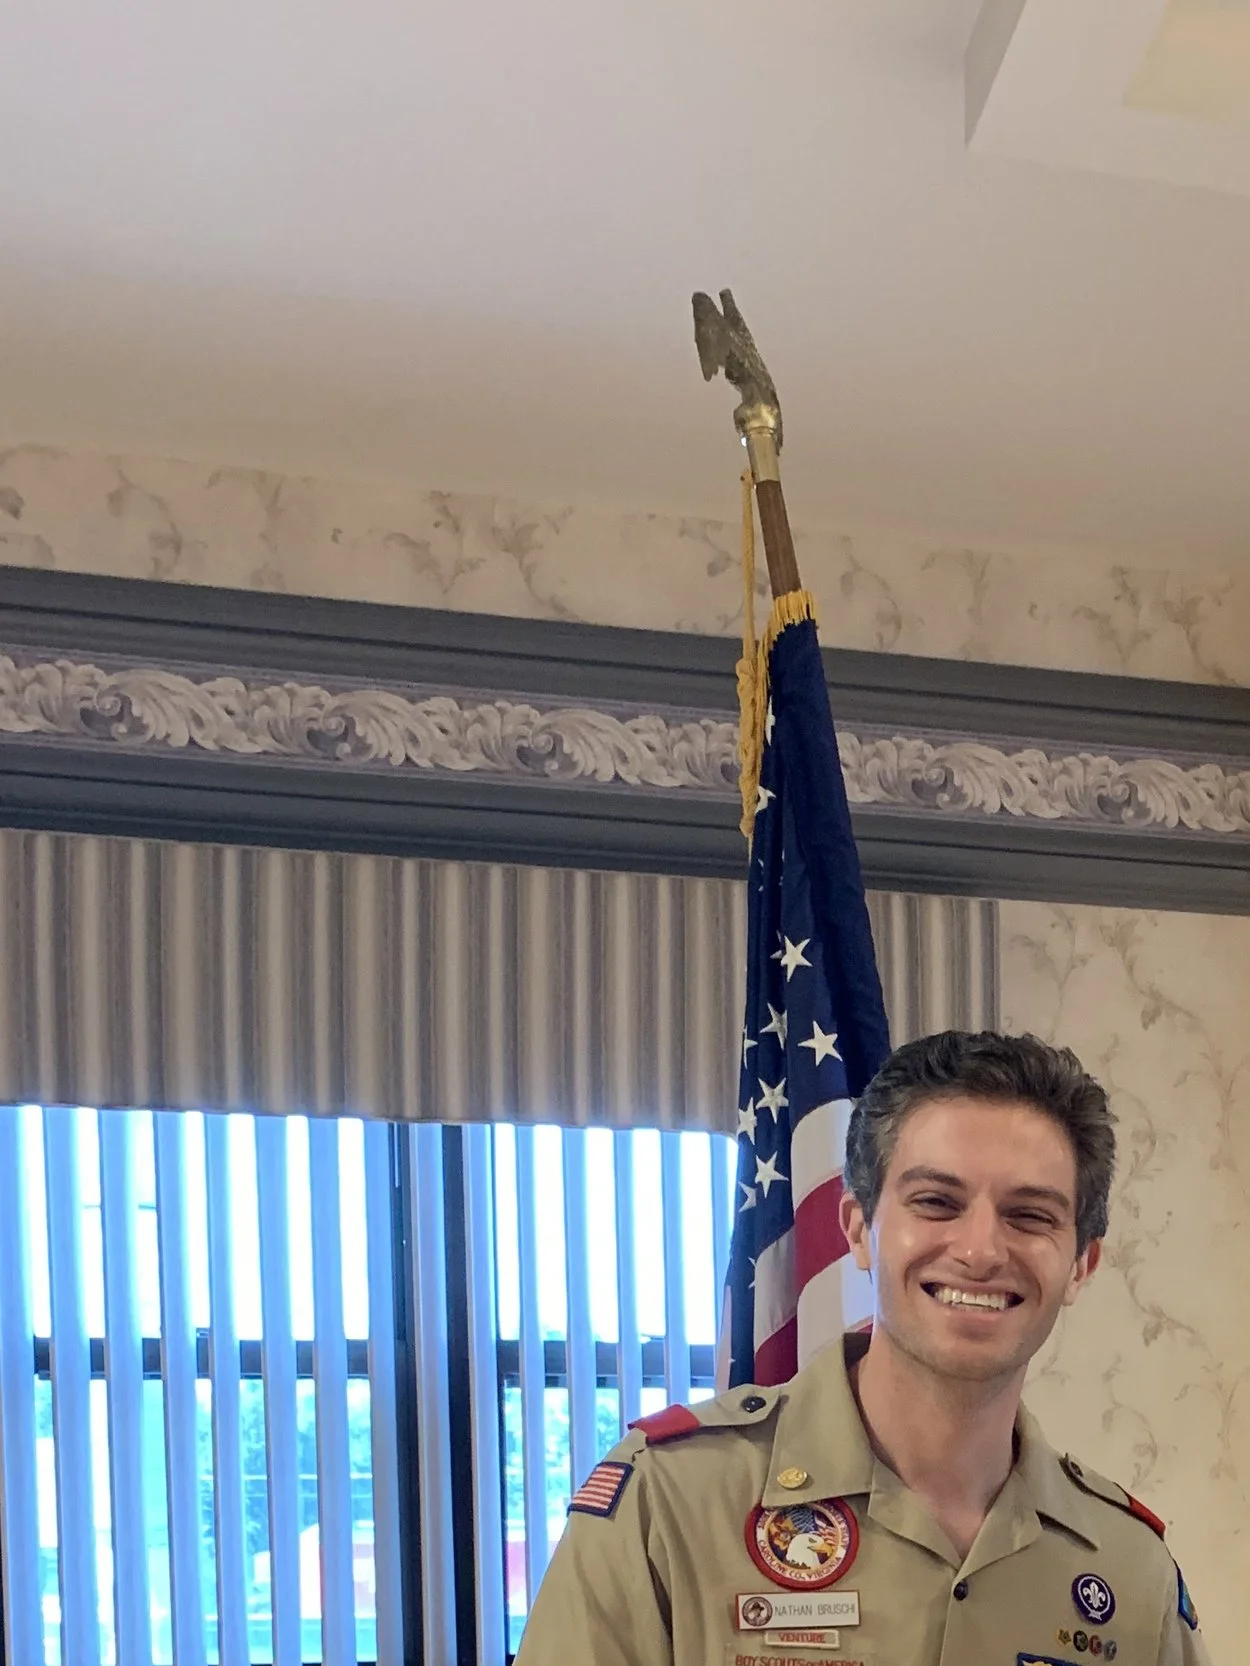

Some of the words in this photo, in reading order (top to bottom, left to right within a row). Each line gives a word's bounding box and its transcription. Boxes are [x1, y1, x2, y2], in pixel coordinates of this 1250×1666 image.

[807, 1557, 842, 1580] VIRGINIA
[774, 1605, 812, 1617] NATHAN
[818, 1603, 856, 1615] BRUSCHI
[779, 1632, 826, 1643] VENTURE
